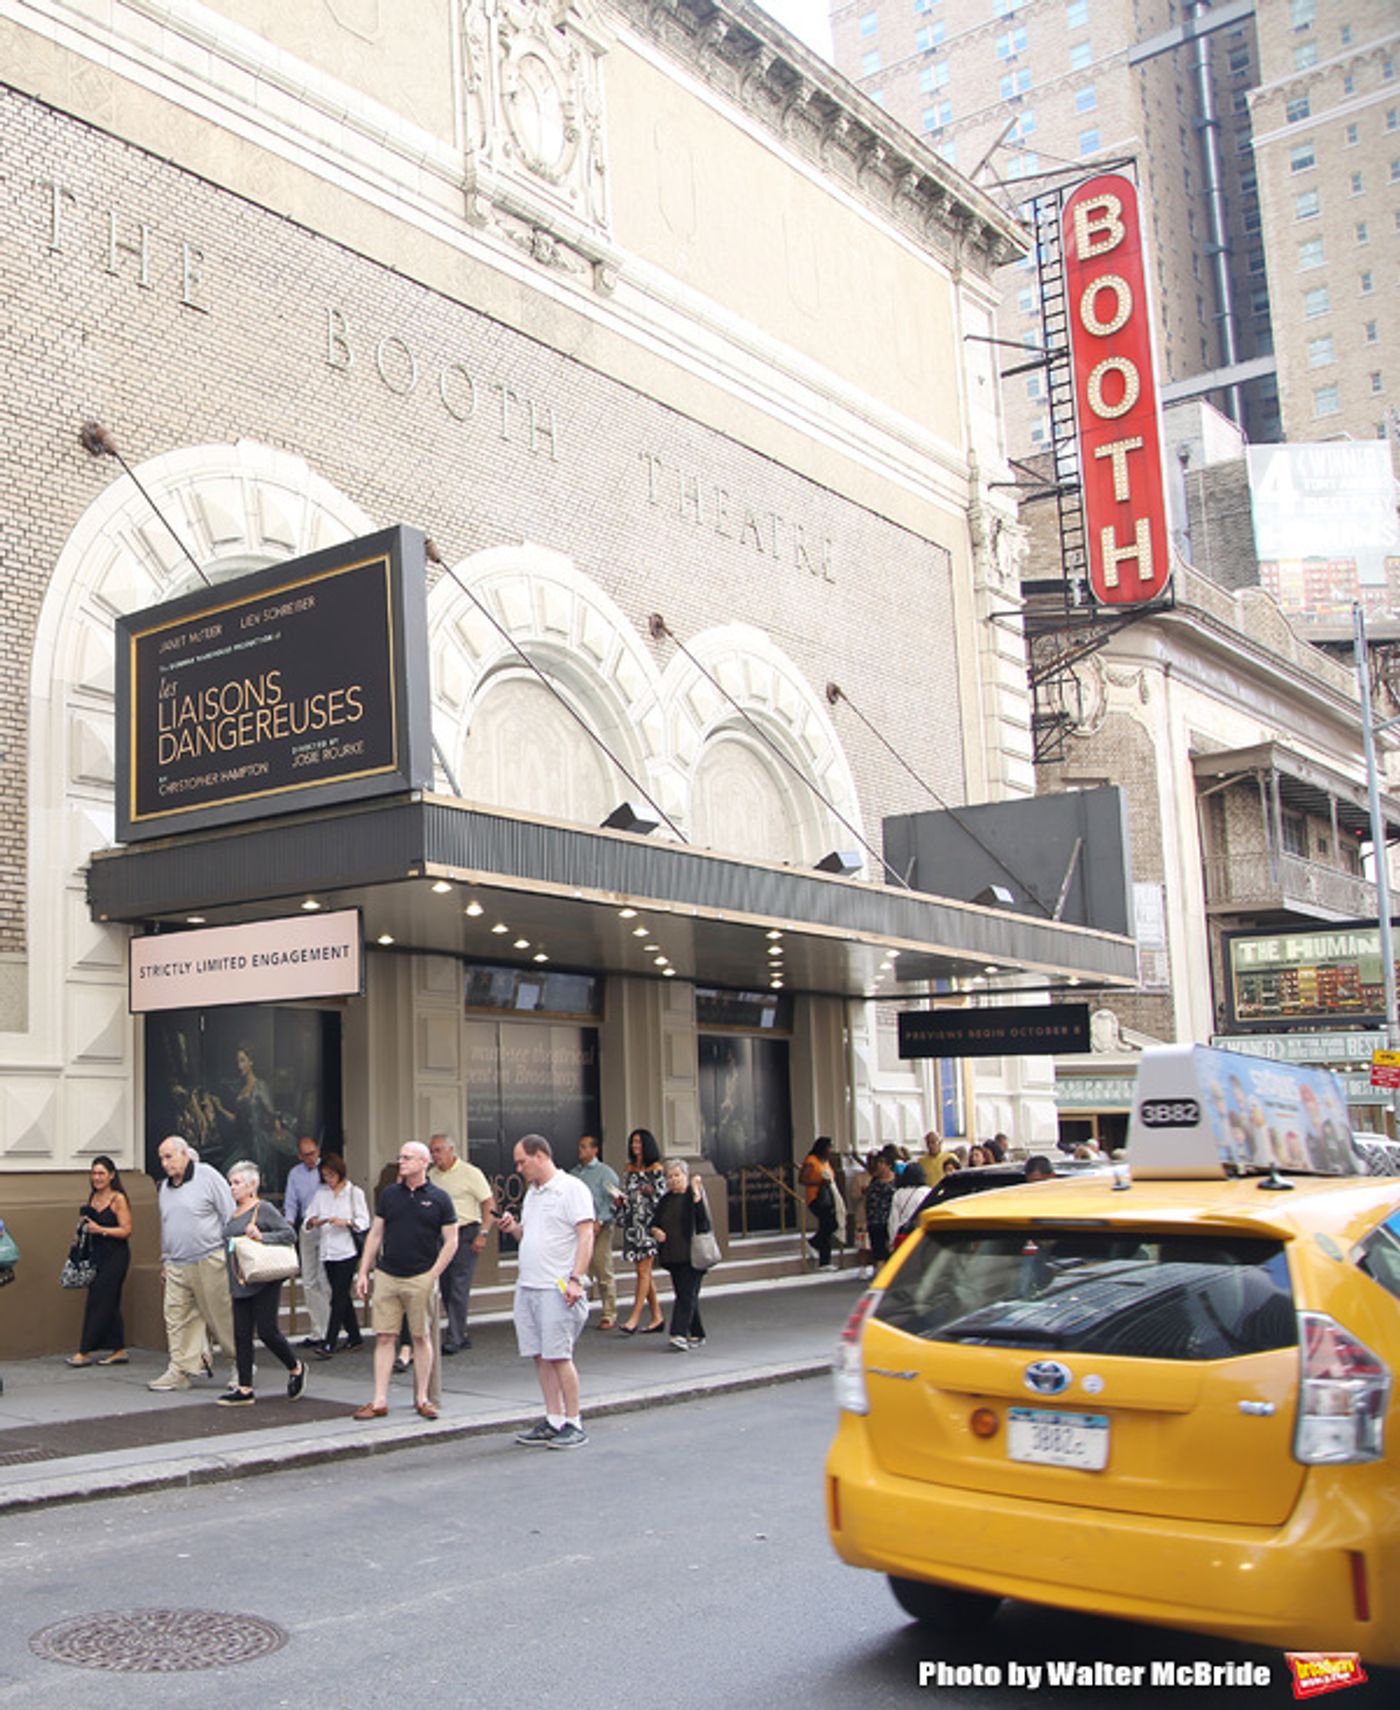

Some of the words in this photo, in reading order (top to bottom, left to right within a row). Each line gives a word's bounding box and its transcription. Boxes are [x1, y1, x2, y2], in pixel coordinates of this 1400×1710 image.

[35, 179, 209, 314] THE
[324, 306, 558, 462] BOOTH
[638, 451, 836, 585] THEATRE
[1073, 193, 1154, 589] BOOTH
[158, 669, 283, 732] LIAISONS
[158, 685, 364, 765] DANGEREUSES
[139, 961, 192, 979] STRICTLY
[196, 956, 246, 974] LIMITED
[251, 945, 350, 968] ENGAGEMENT
[1238, 940, 1280, 963] THE
[1285, 934, 1381, 960] HUMAN
[905, 1029, 963, 1041] PREVIEWS
[968, 1027, 1005, 1039] BEGIN
[1010, 1024, 1068, 1038] OCTOBER
[1346, 1035, 1379, 1056] BEST
